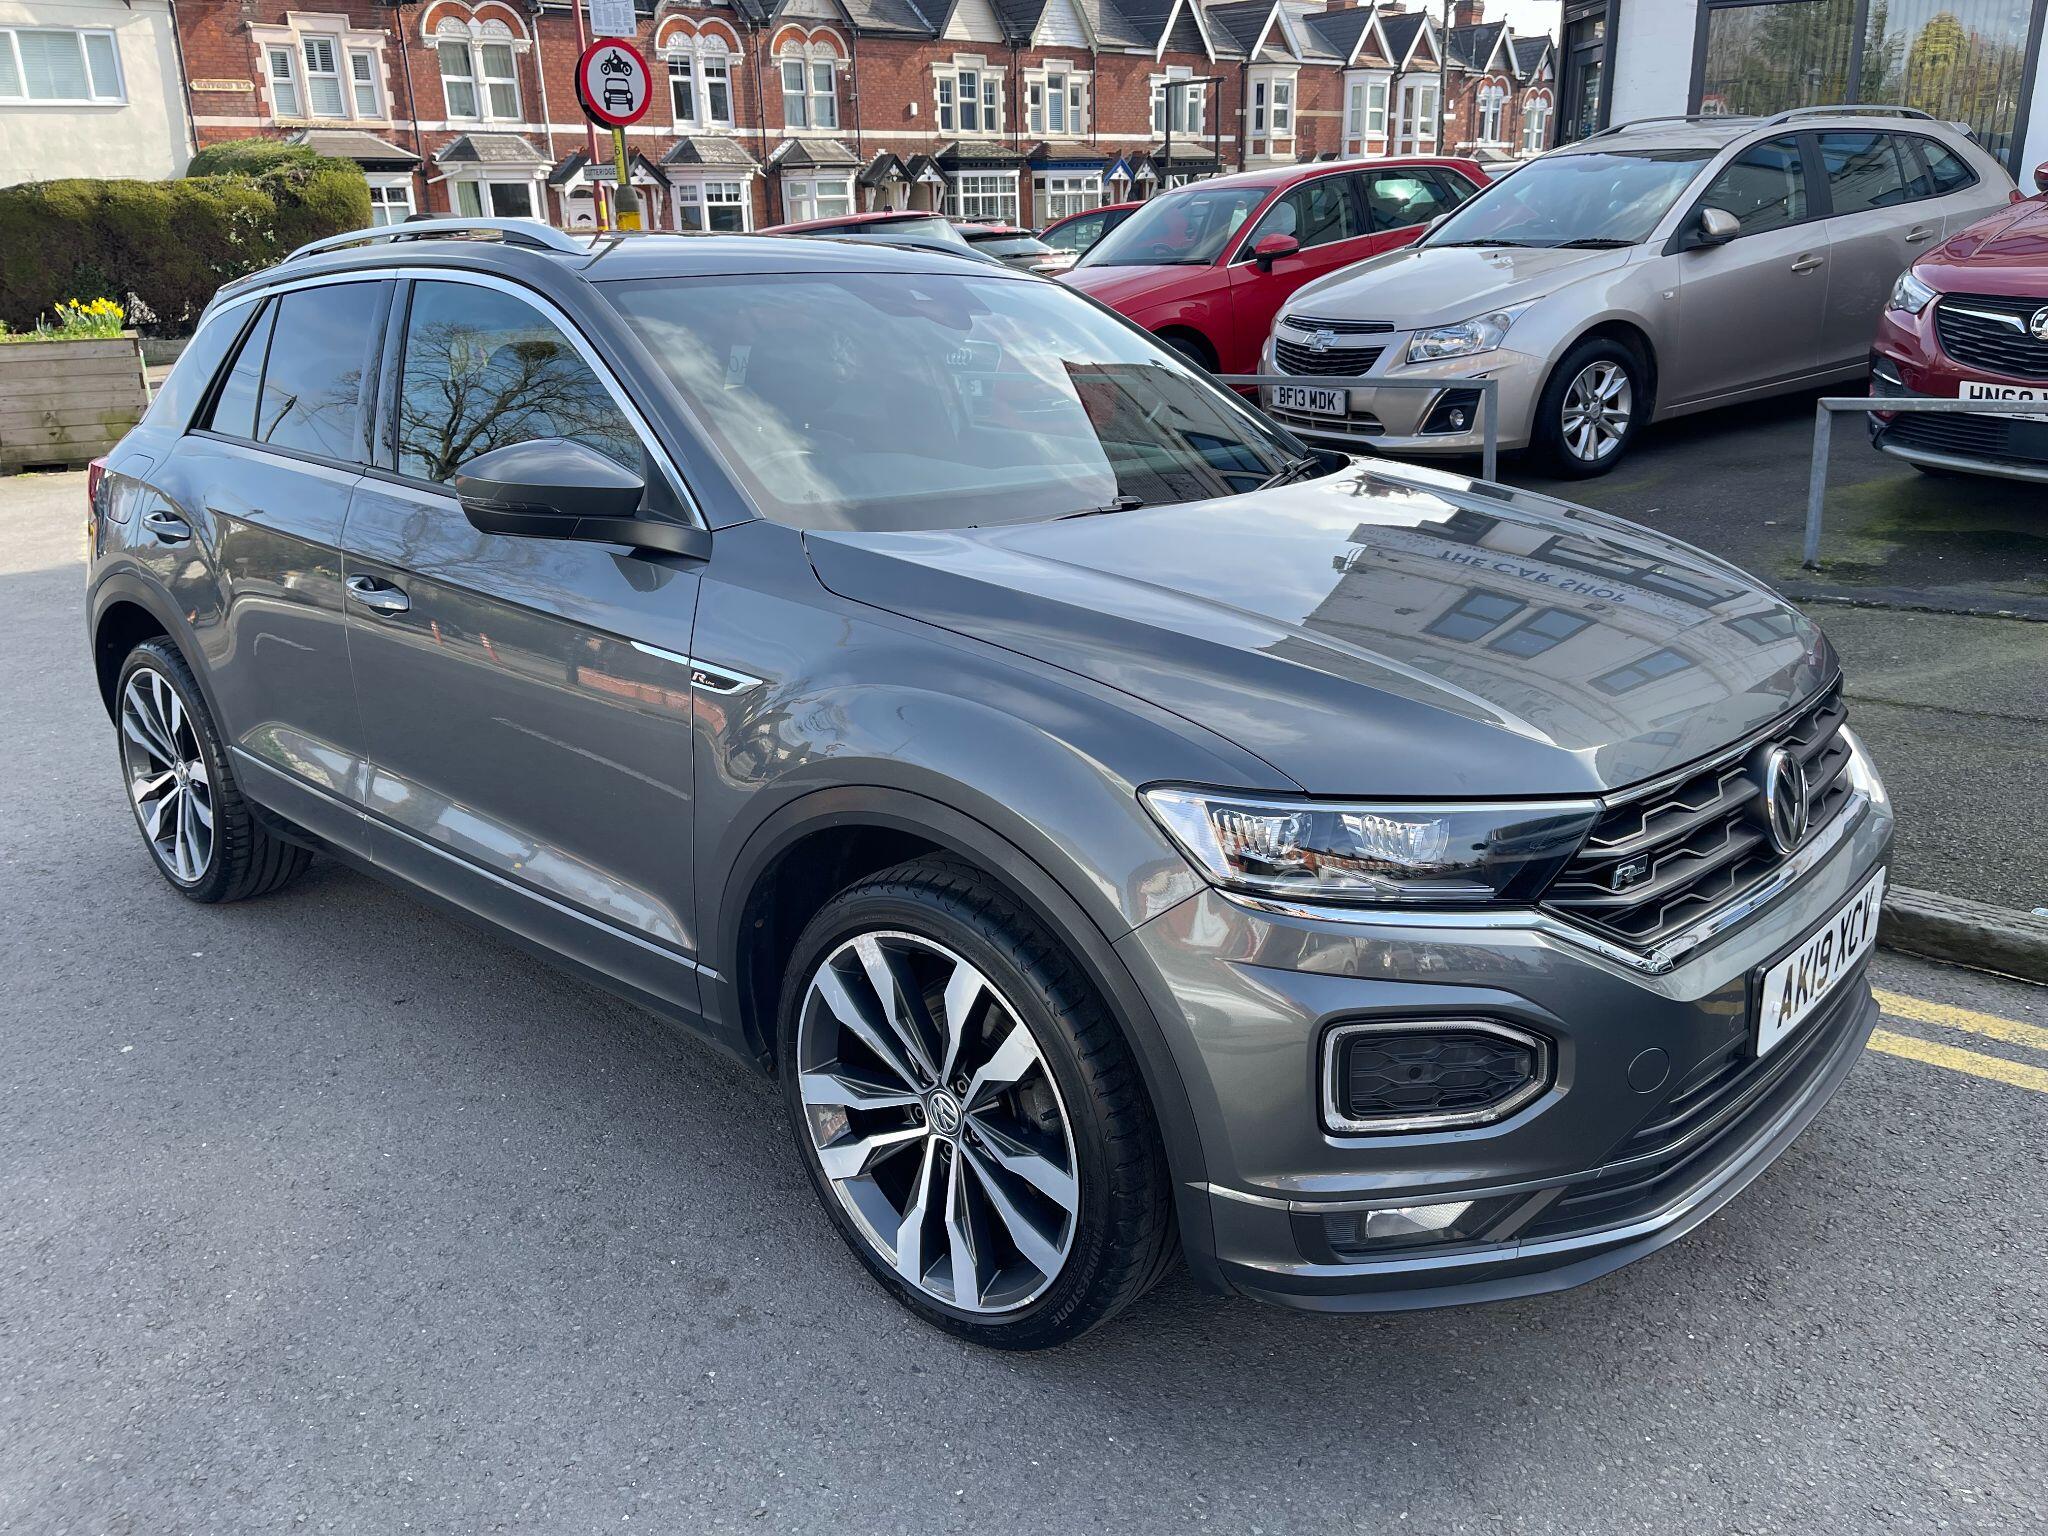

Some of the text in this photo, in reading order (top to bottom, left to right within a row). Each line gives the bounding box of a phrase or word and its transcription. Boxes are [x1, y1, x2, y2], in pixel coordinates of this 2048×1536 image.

[1279, 387, 1336, 411] BF13 MDK
[1777, 929, 1834, 1029] AK19
[1834, 885, 1875, 973] XCV
